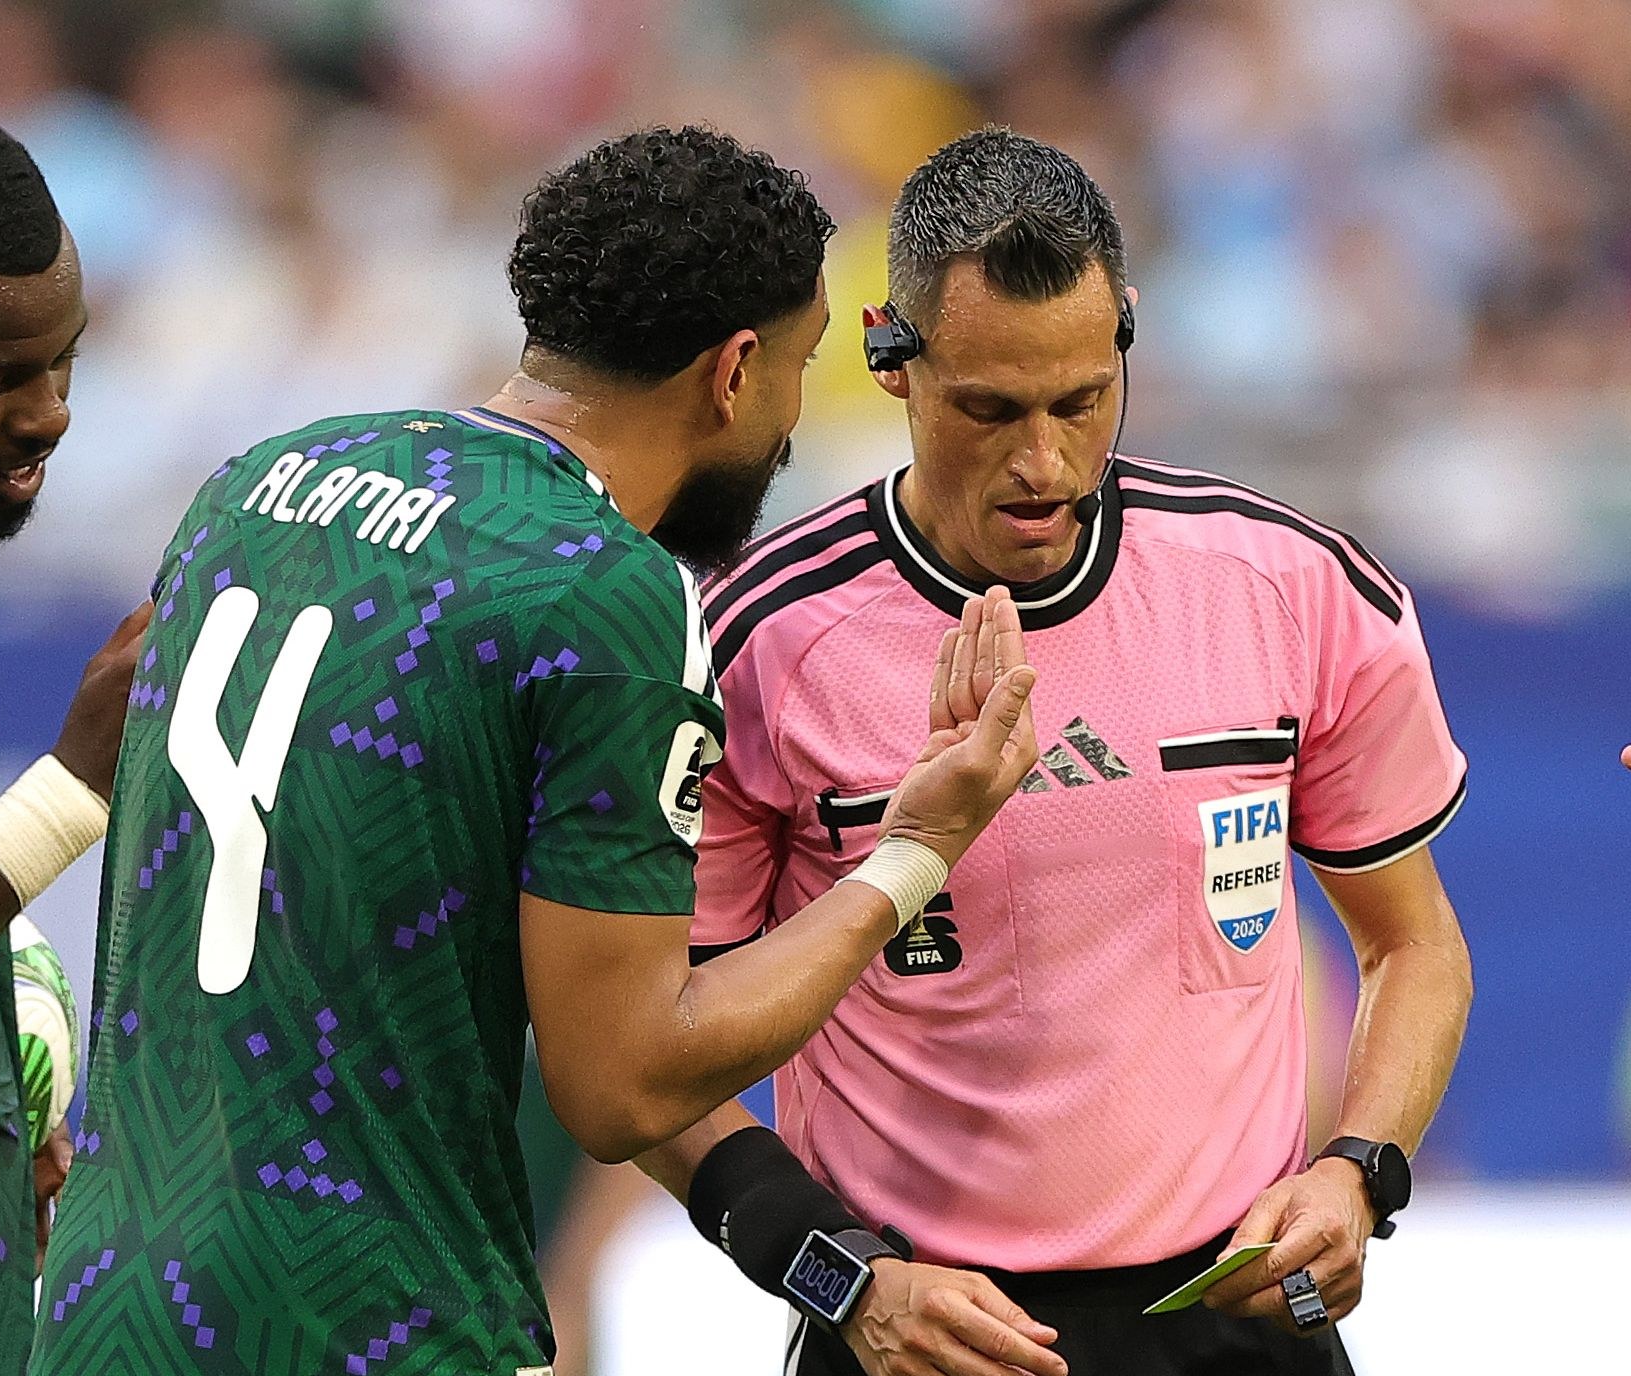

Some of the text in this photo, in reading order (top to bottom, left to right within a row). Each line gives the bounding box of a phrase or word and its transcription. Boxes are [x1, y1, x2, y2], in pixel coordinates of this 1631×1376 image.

[241, 451, 457, 554] ALAMRI
[167, 586, 334, 995] 4
[1211, 799, 1283, 848] FIFA
[1211, 861, 1282, 893] REFEREE
[1231, 916, 1265, 941] 2026
[905, 949, 944, 966] FIFA
